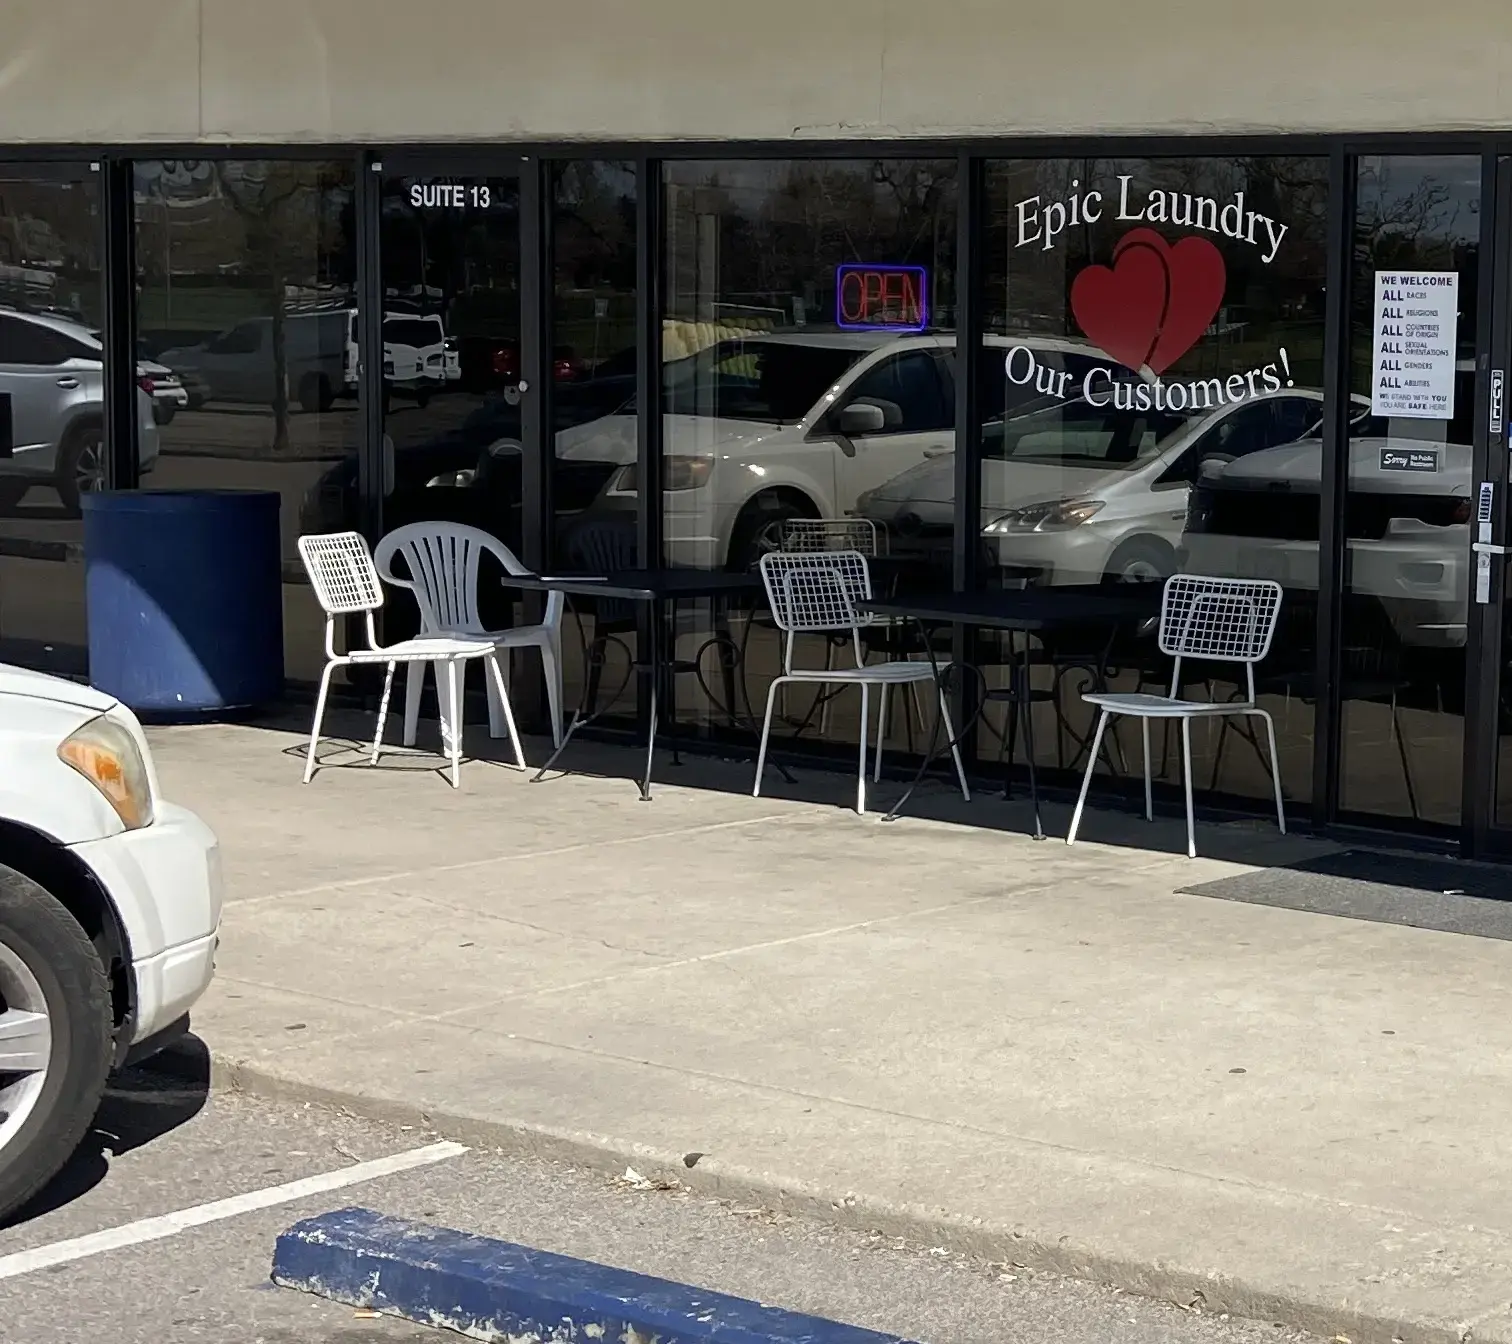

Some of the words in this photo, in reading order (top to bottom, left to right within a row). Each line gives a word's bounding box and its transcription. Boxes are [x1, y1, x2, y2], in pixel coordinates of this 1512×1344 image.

[410, 184, 465, 207] SUITE
[470, 186, 491, 208] 13
[1014, 179, 1103, 251] Epic
[1115, 175, 1288, 263] Laundry
[1381, 276, 1397, 285] WE
[1400, 276, 1453, 286] WELCOME
[841, 271, 923, 324] OPEN
[1382, 290, 1404, 301] ALL
[1381, 307, 1404, 319] ALL
[1381, 324, 1403, 336] ALL
[1380, 342, 1402, 353] ALL
[1380, 359, 1401, 371] ALL
[1005, 345, 1073, 399] Our
[1083, 347, 1294, 411] Customers!
[1380, 376, 1401, 388] ALL
[1492, 379, 1501, 419] PULL
